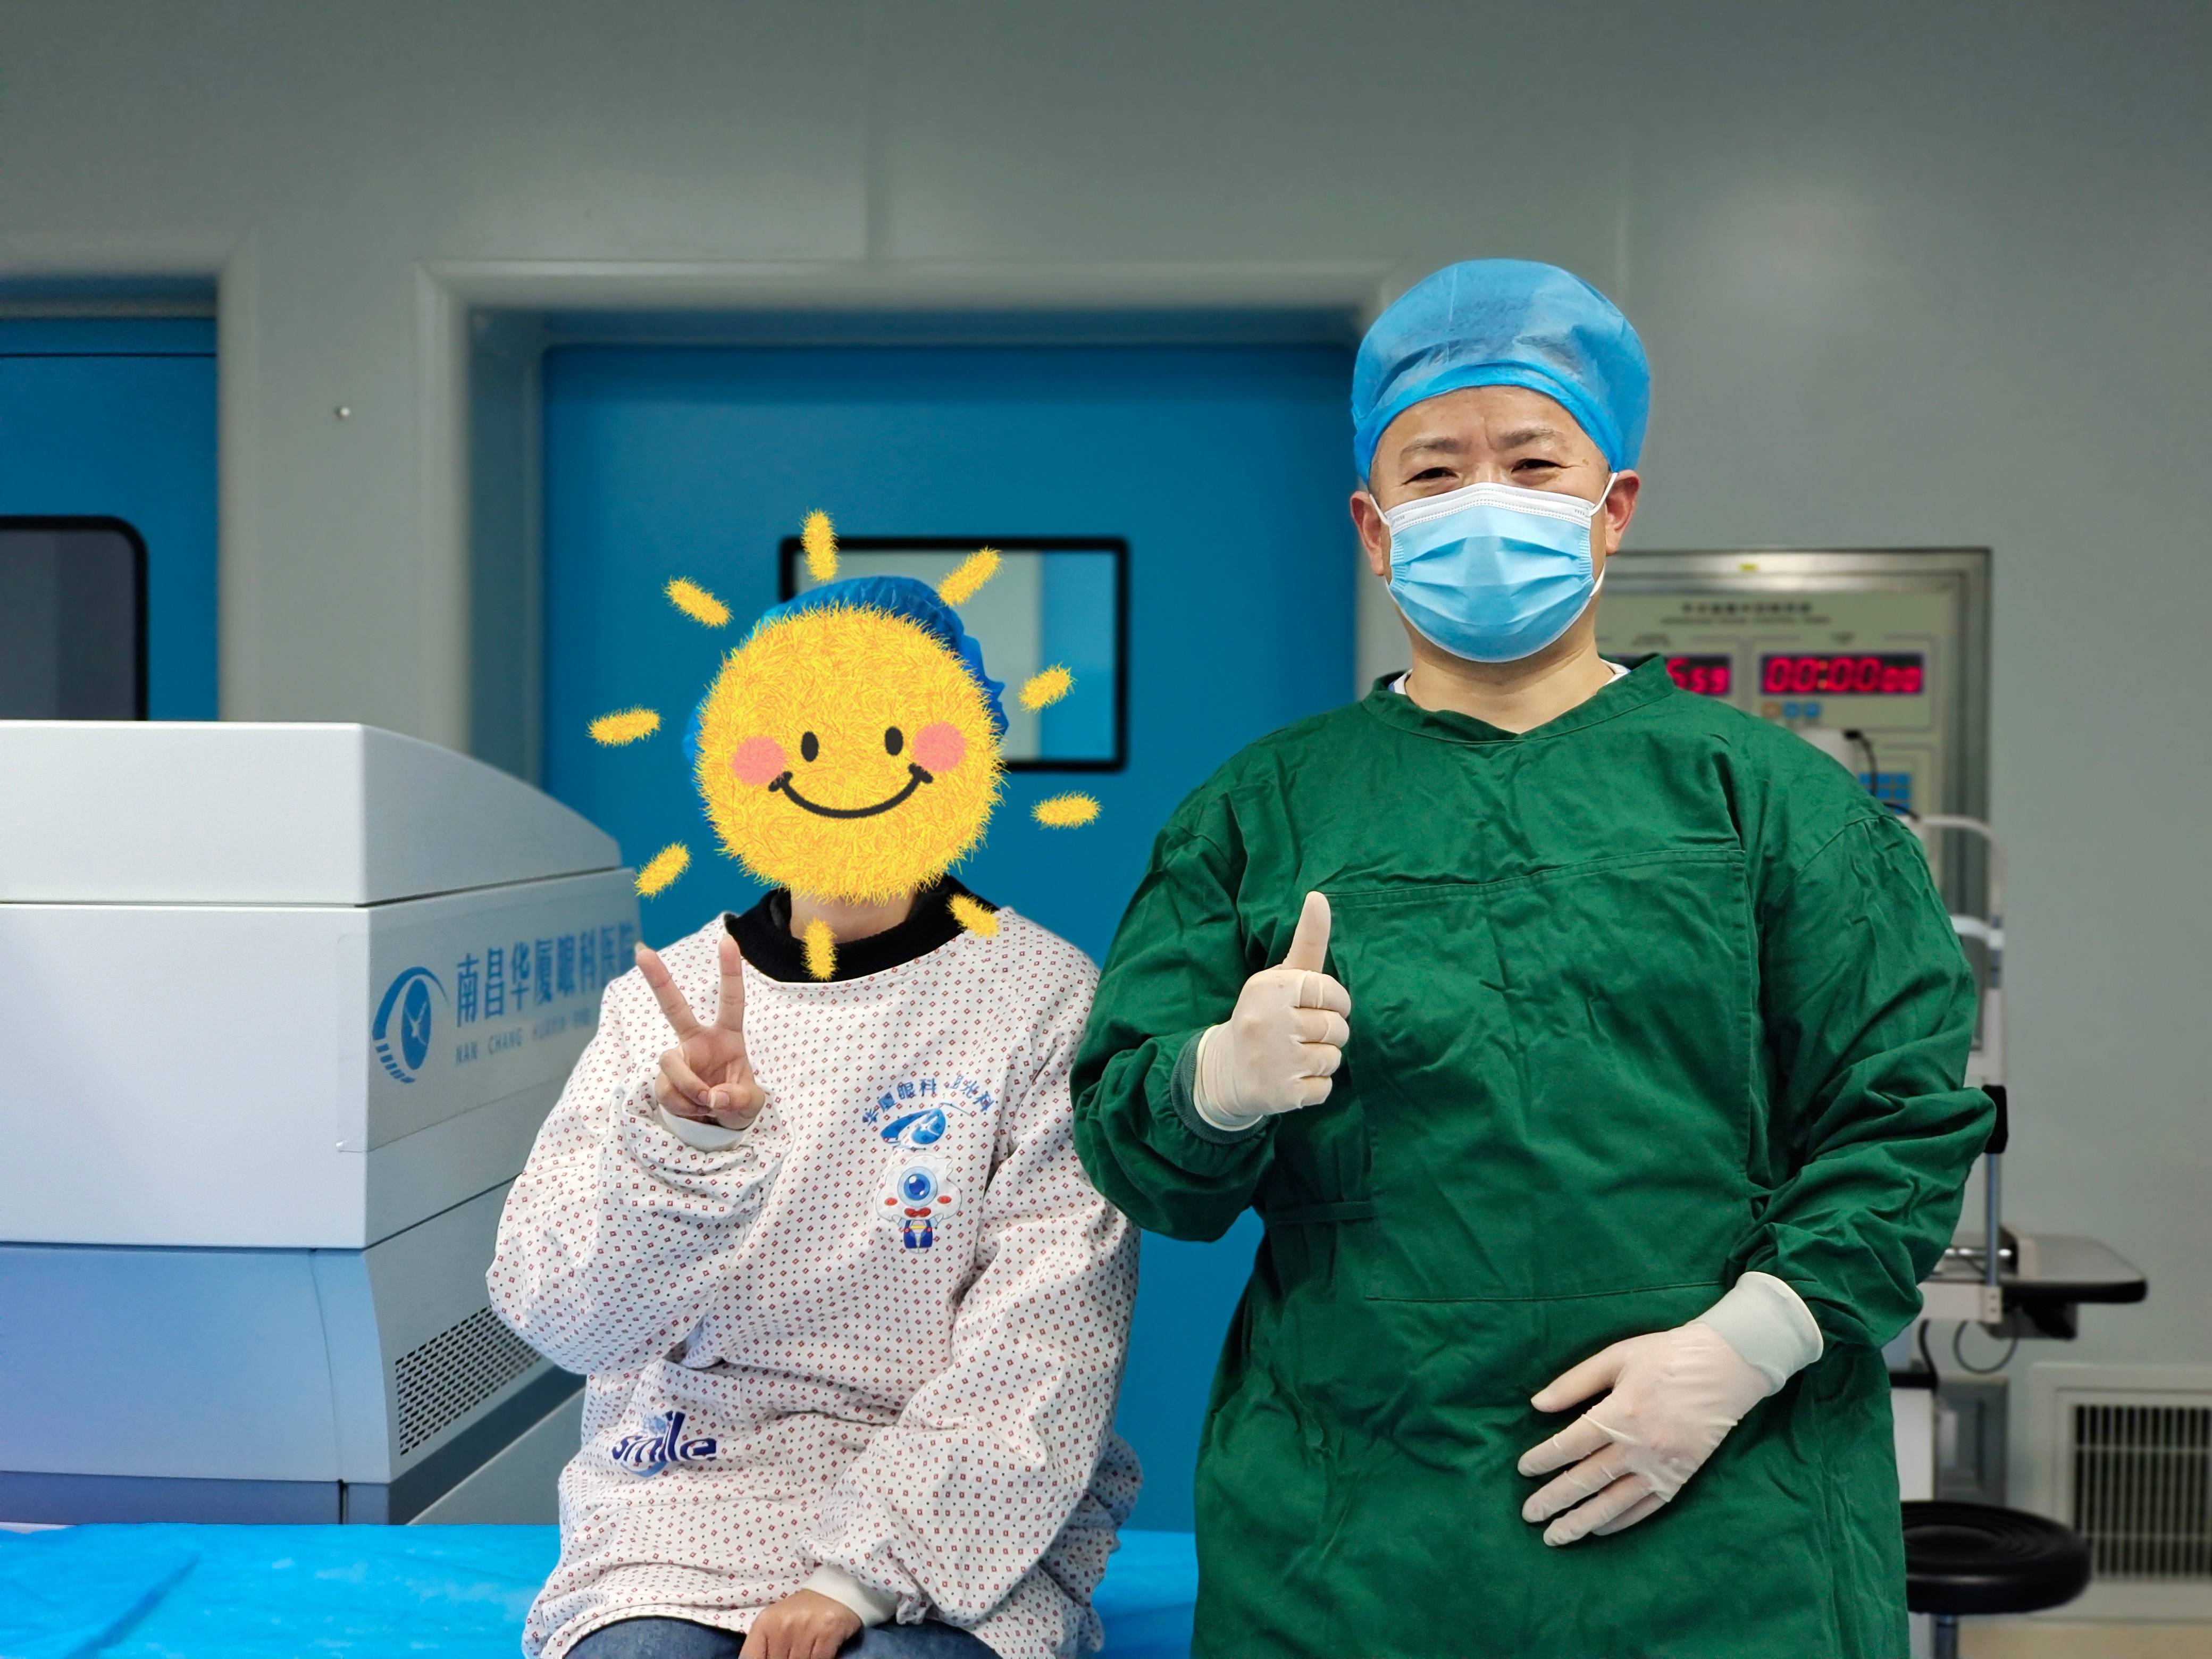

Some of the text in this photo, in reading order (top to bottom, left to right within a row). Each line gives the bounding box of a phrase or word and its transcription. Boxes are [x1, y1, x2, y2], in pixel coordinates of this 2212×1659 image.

[455, 1041, 477, 1064] NAN
[488, 1027, 523, 1055] CHANG
[613, 1411, 716, 1462] smile
